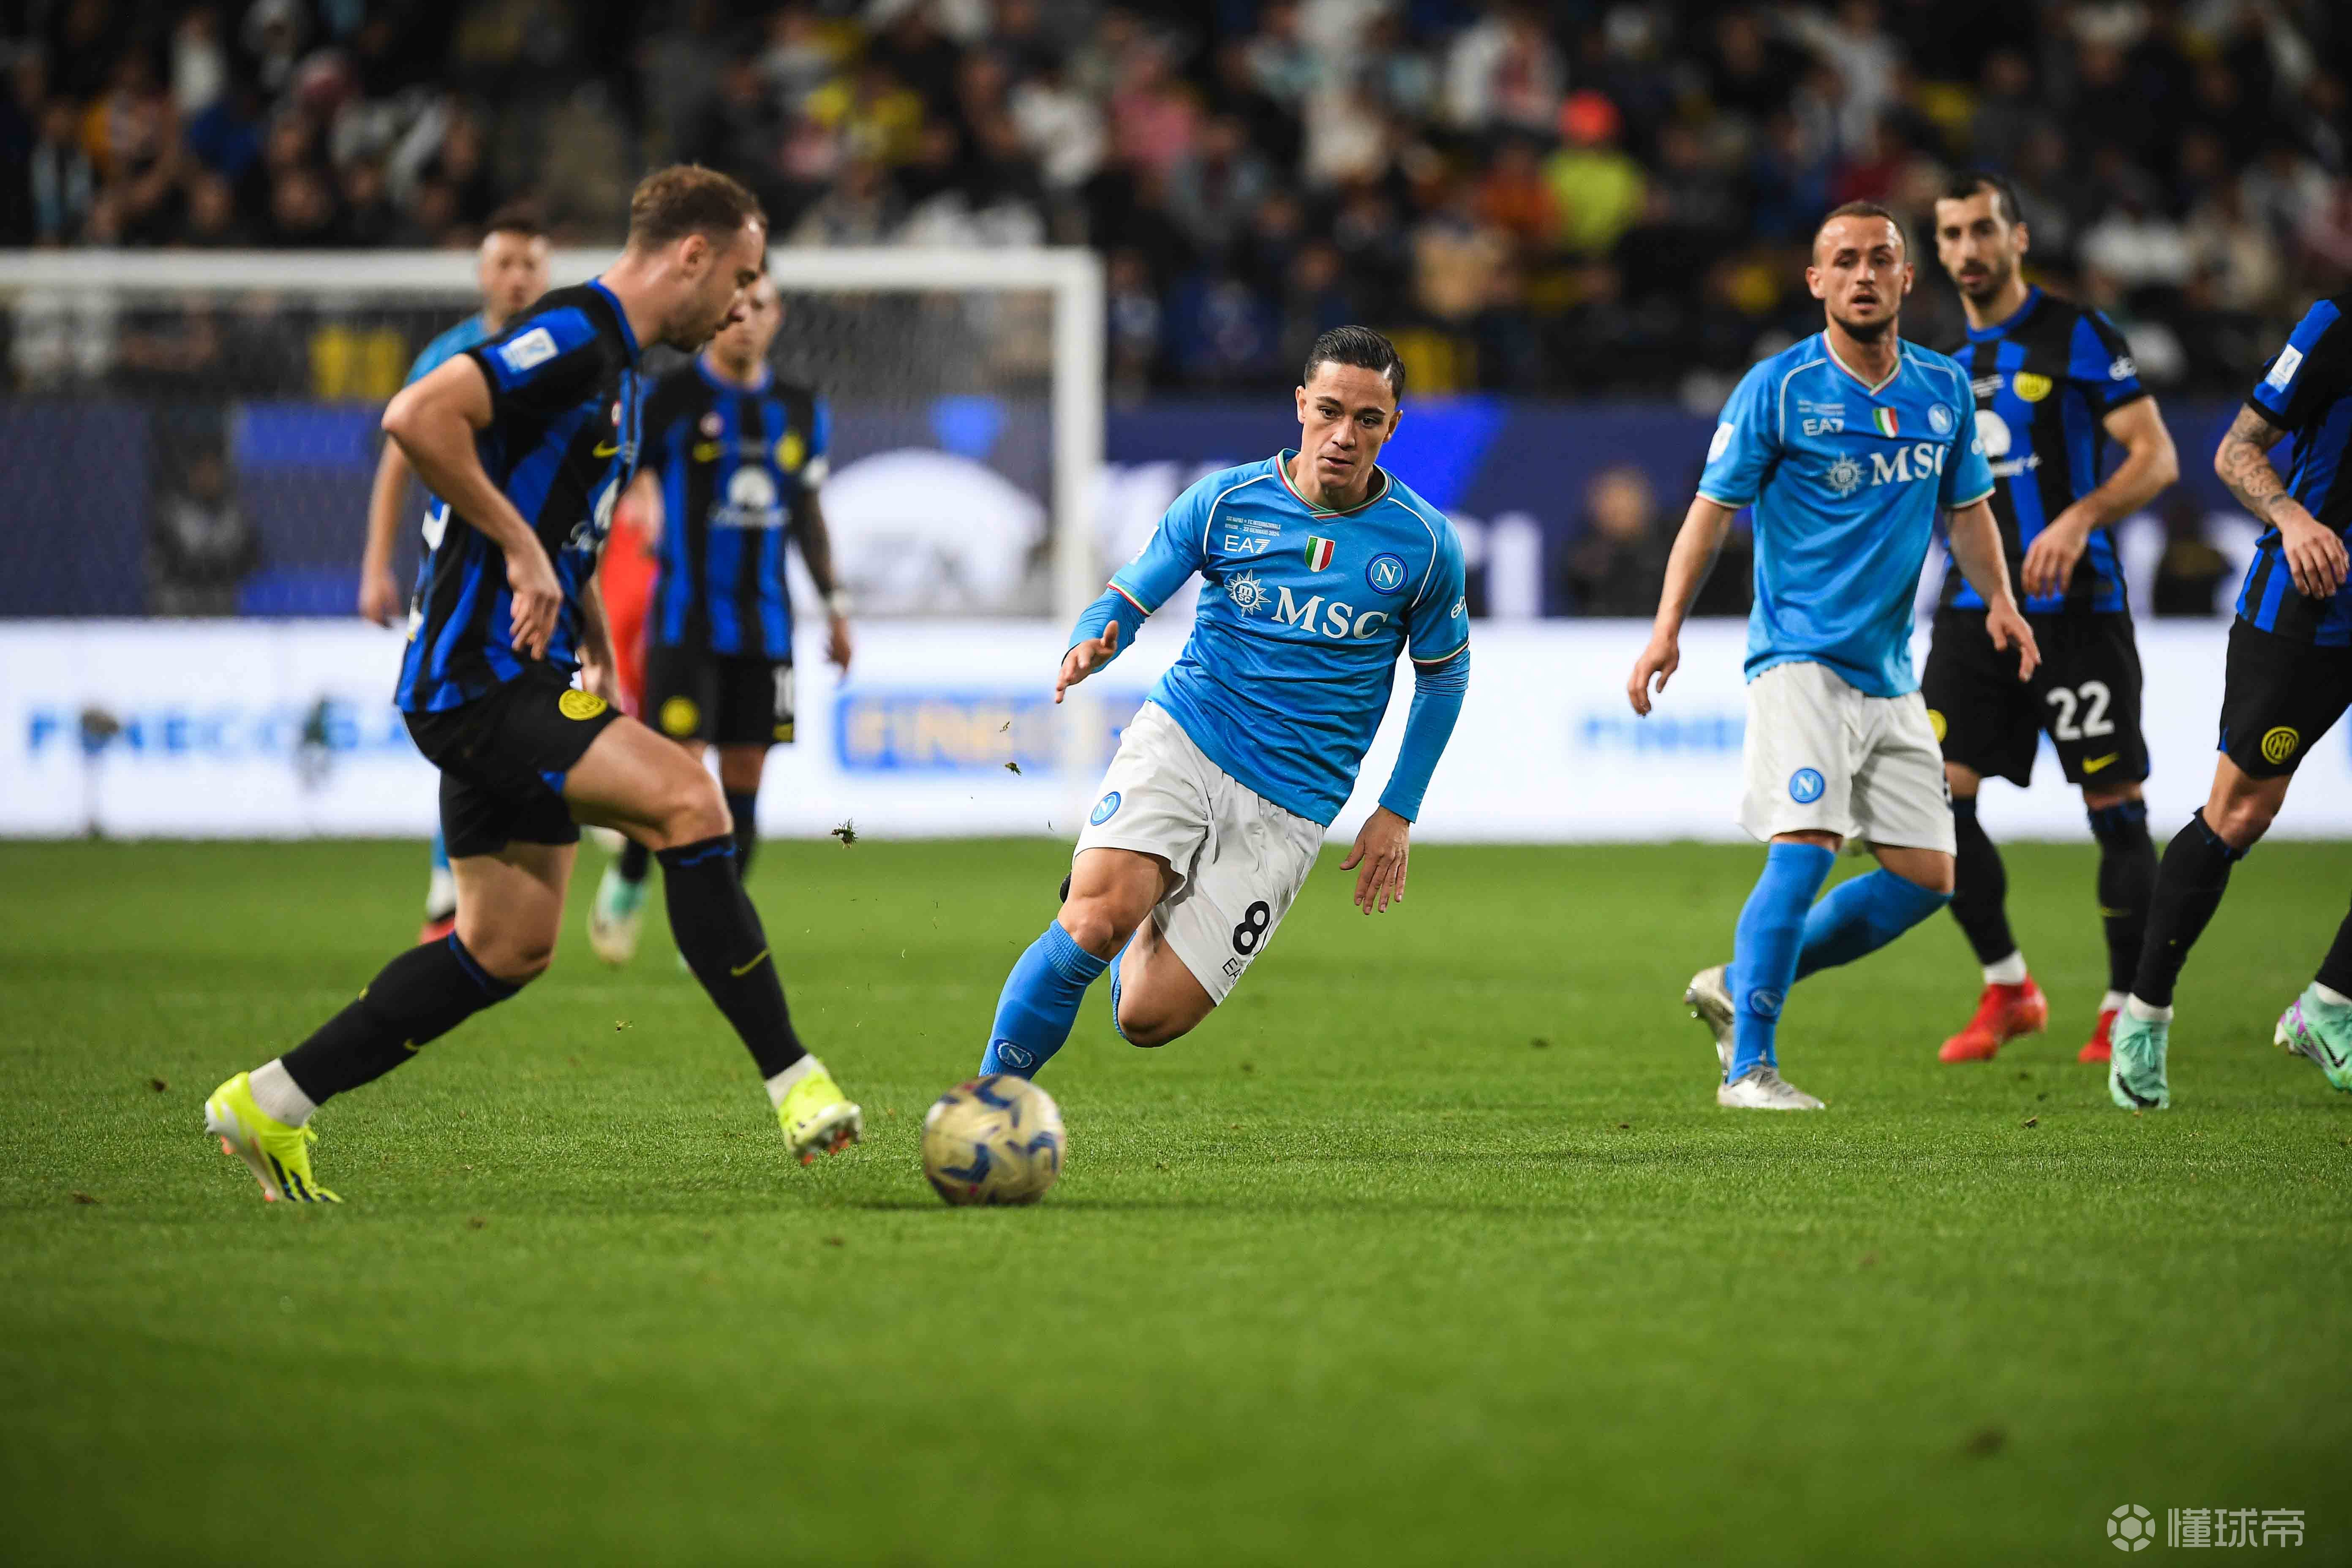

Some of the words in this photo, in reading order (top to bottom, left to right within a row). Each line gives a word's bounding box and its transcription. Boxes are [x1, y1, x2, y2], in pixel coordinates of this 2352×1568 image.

[1802, 418, 1844, 436] EA7
[1225, 534, 1271, 554] EA7
[1376, 563, 1397, 585] N
[1271, 586, 1388, 639] MSC
[2046, 679, 2115, 741] 22
[1233, 900, 1270, 955] 8
[1222, 957, 1241, 985] EA
